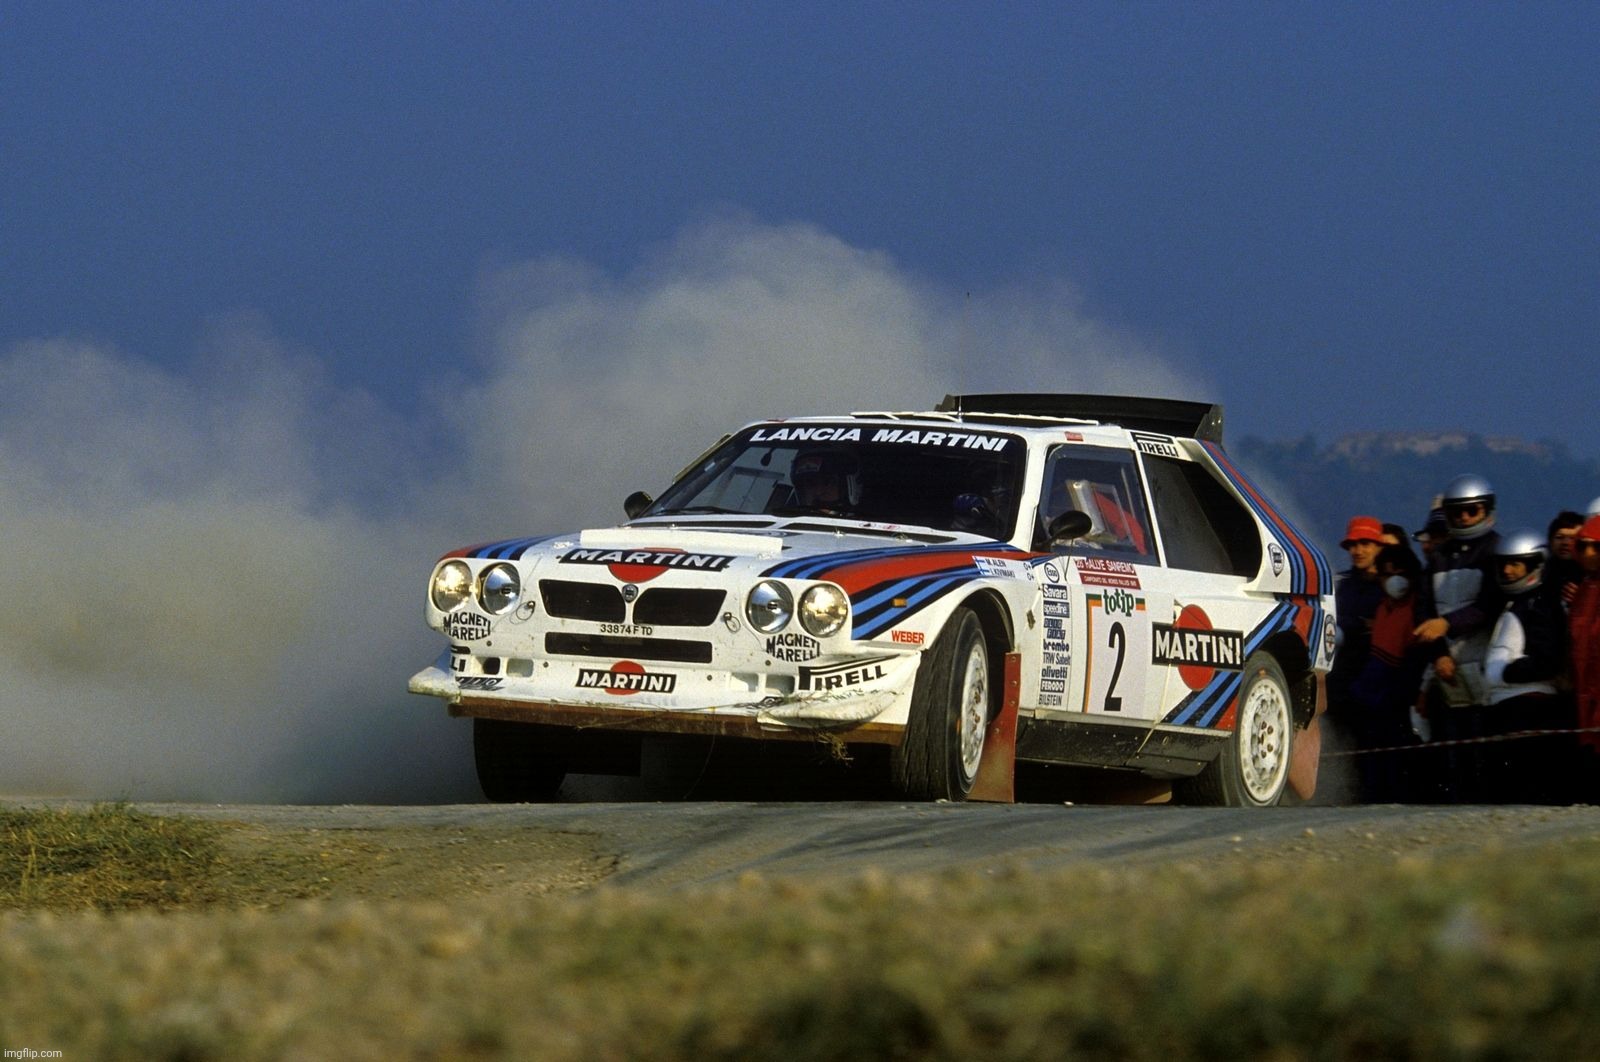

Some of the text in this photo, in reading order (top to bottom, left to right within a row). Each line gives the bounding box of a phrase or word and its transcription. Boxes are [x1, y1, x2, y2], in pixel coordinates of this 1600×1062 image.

[750, 427, 1008, 452] LANCIA MARTINI
[1130, 432, 1179, 457] PIRELLI
[570, 549, 725, 568] MARTINI
[1106, 560, 1135, 574] SANREMO
[1043, 584, 1067, 599] Savara
[1044, 603, 1068, 615] speedline
[1103, 588, 1134, 617] totip
[443, 612, 491, 629] MAGNETI
[443, 625, 491, 641] MARELLI
[600, 624, 653, 636] 33874 F TO
[892, 630, 925, 645] WEBER
[766, 633, 820, 650] MAGNETI
[1043, 639, 1070, 652] brembo
[1155, 629, 1241, 665] MARTINI
[766, 645, 820, 662] MARELLI
[1043, 652, 1055, 664] TRW
[1041, 665, 1068, 679] olivetti
[1104, 621, 1126, 712] 2
[580, 671, 672, 692] MARTINI
[1041, 680, 1064, 692] FERODO
[1038, 693, 1063, 706] BILSTEIN
